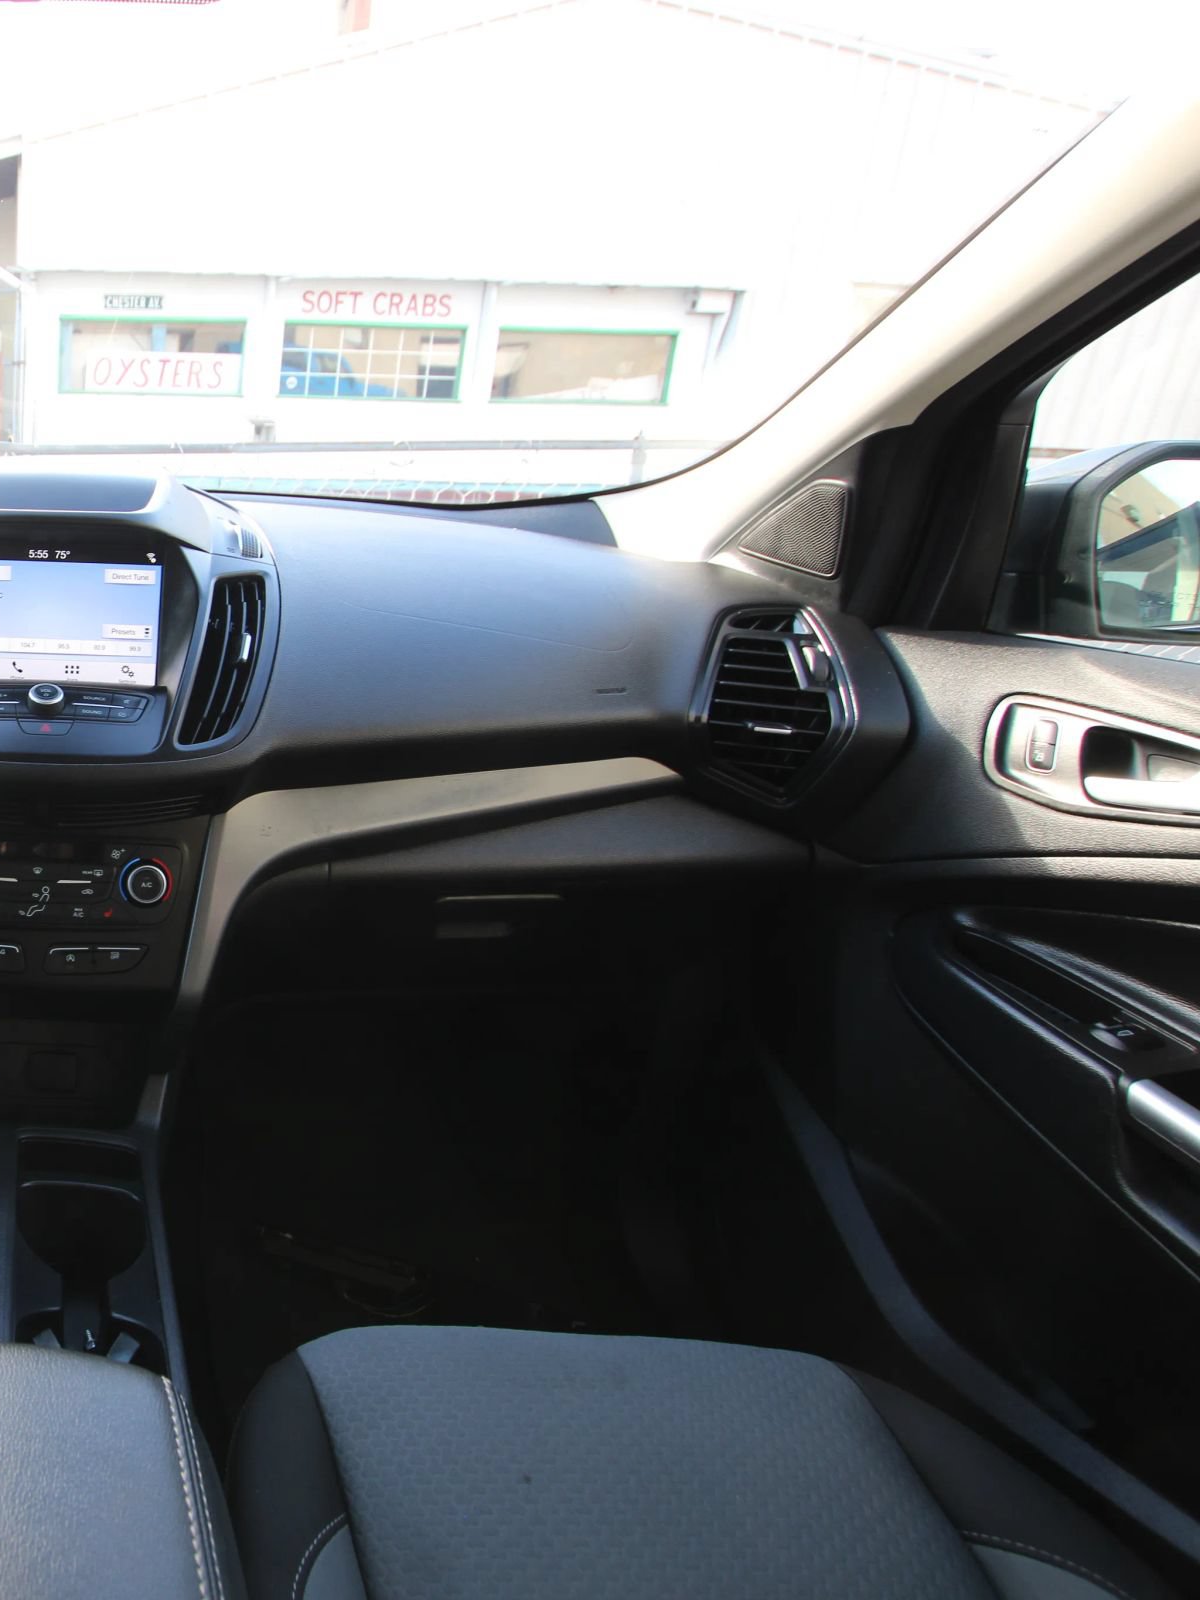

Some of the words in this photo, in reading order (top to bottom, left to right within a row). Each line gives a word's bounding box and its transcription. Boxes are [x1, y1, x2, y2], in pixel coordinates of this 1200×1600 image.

[106, 295, 146, 308] CHESTER
[301, 290, 363, 314] SOFT
[373, 292, 452, 317] CRABS
[93, 357, 223, 389] OYSTERS
[28, 549, 49, 559] 5:55
[112, 573, 132, 581] Direct
[111, 628, 136, 636] Presets
